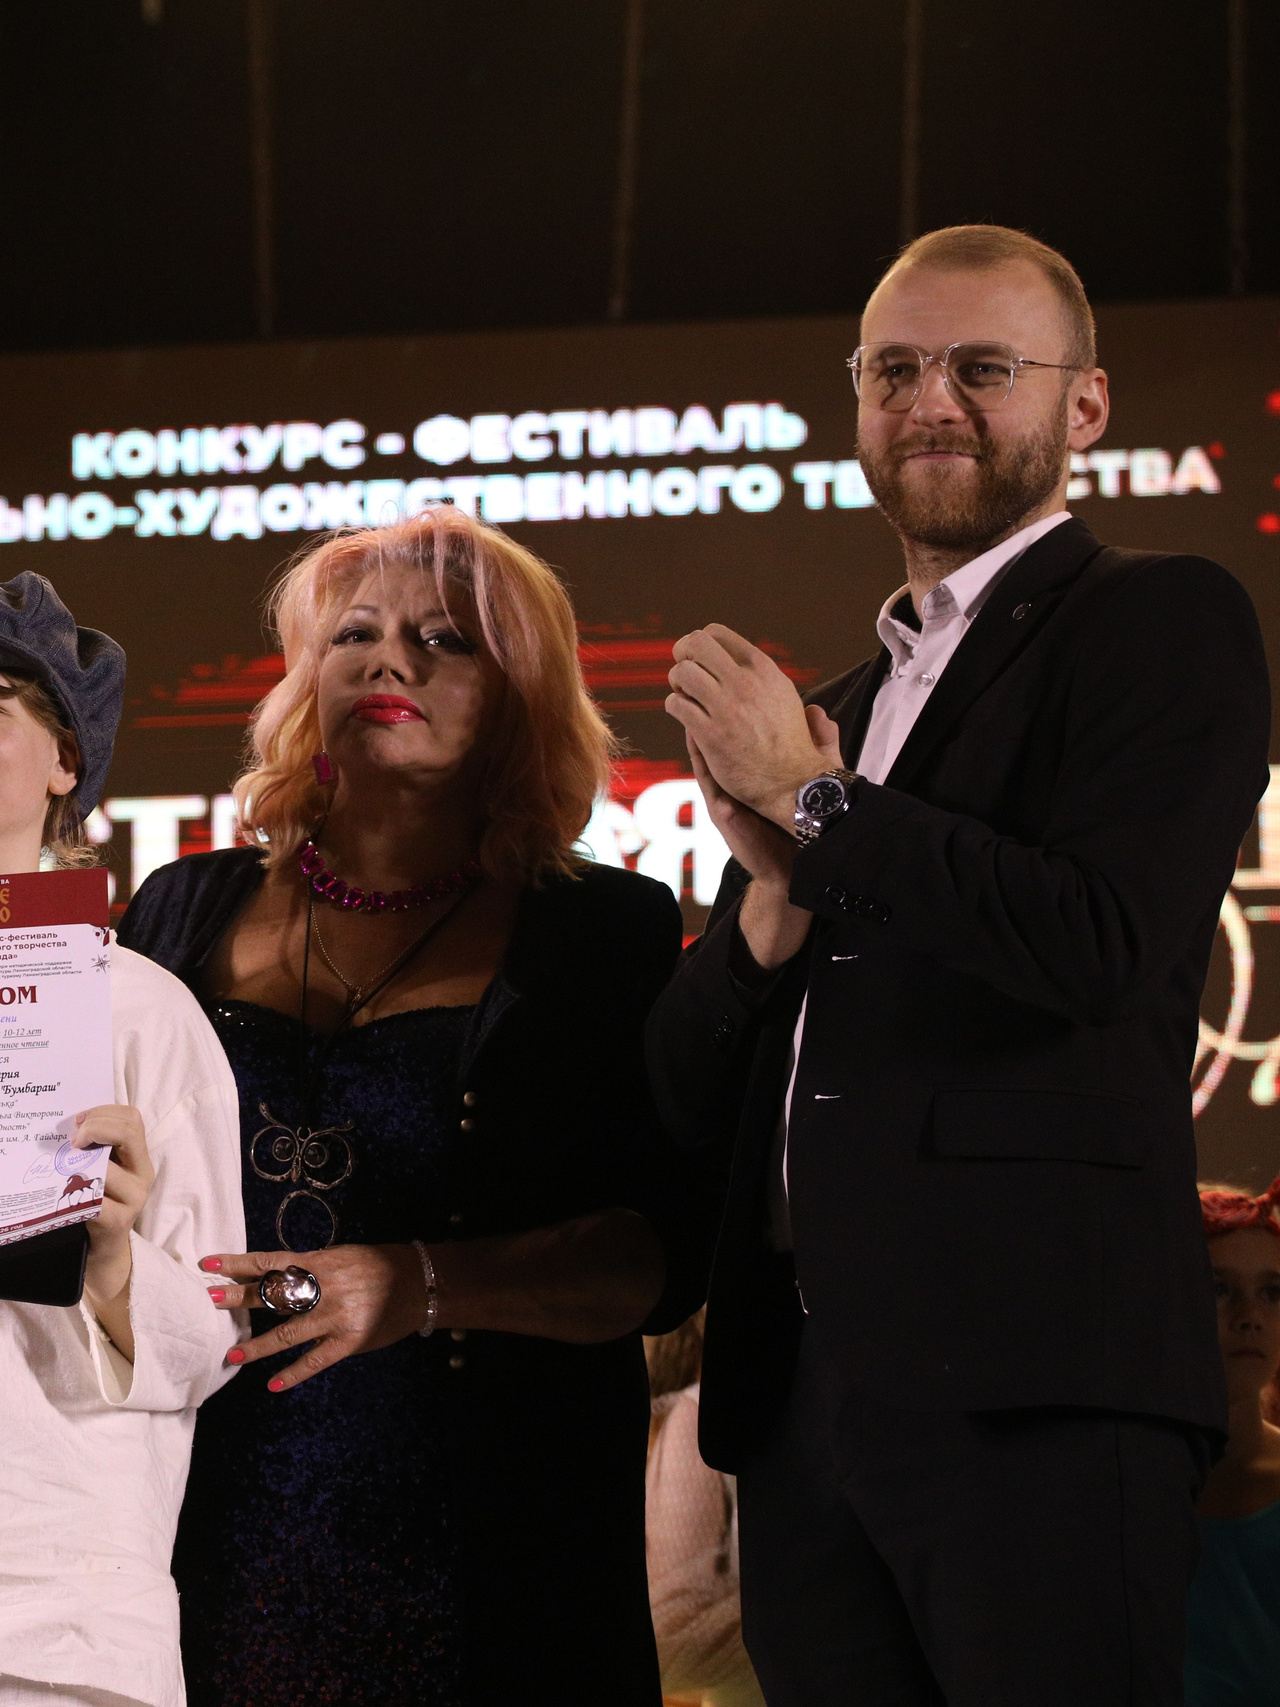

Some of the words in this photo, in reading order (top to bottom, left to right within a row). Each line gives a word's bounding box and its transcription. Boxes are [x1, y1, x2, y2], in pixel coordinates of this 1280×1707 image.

[73, 420, 366, 479] КОНКУРС
[414, 403, 807, 465] ФЕСТИВАЛЬ
[14, 941, 67, 952] творчества
[3, 1028, 25, 1037] 10-12
[1, 1081, 61, 1097] "Бумбараш"
[14, 1110, 64, 1119] Викторовна
[33, 1131, 67, 1142] Гайдара
